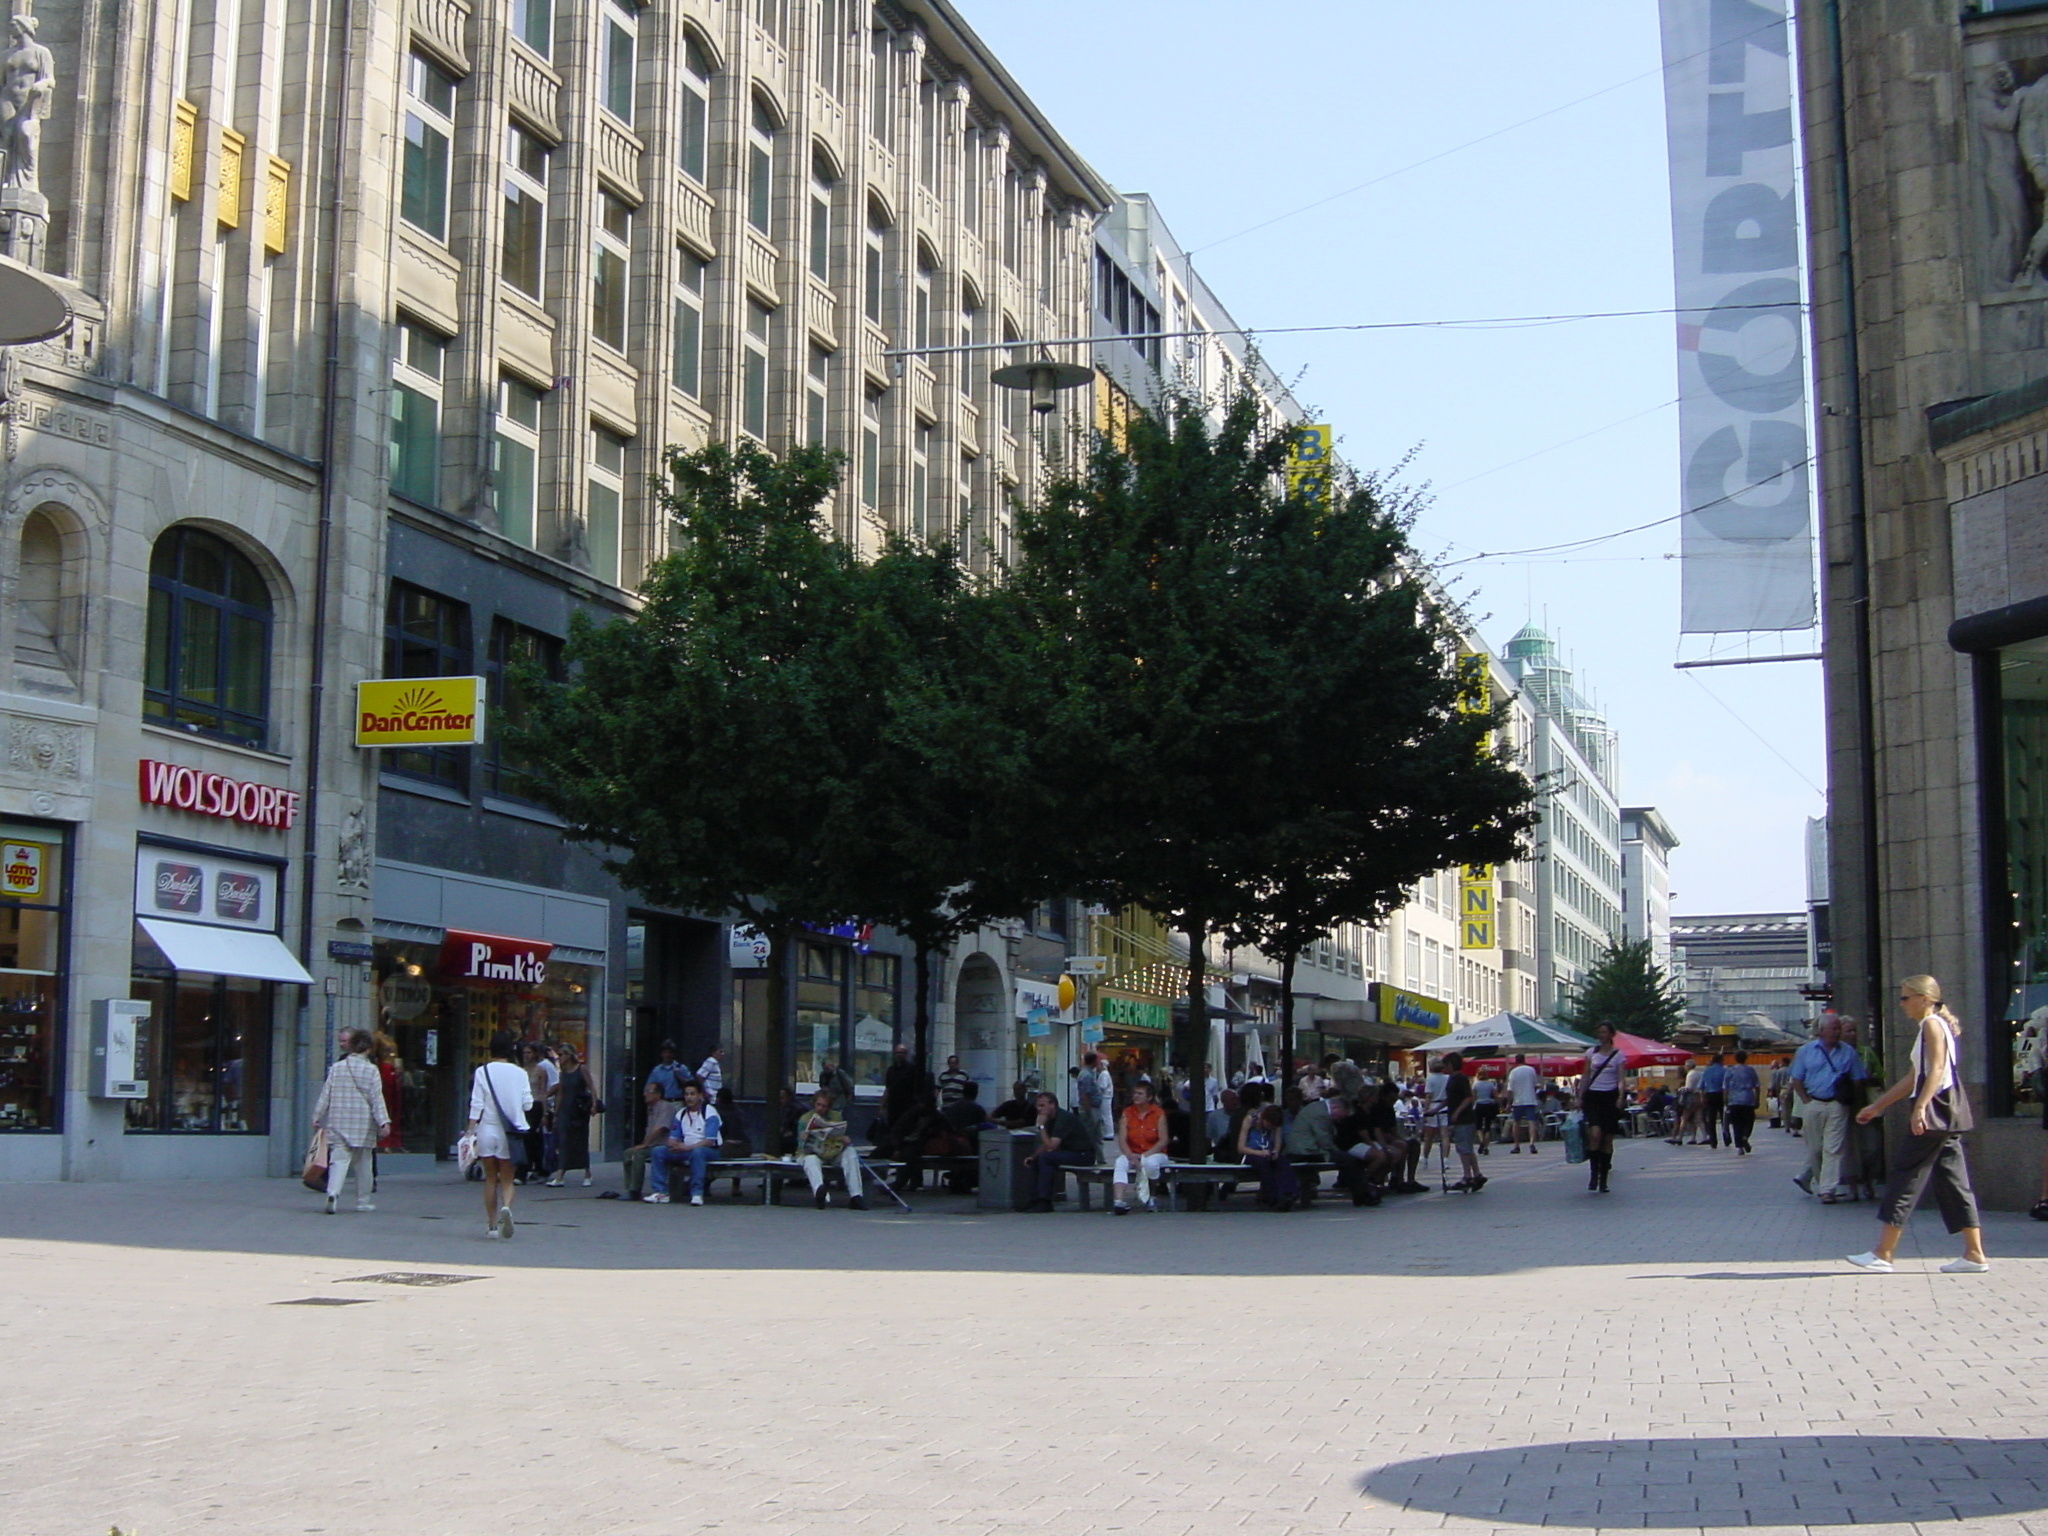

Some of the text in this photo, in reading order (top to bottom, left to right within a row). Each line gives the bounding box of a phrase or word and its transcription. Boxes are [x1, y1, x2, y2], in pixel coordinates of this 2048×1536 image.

[361, 711, 475, 733] DanCenter
[149, 761, 300, 828] WOLSDORFF
[5, 864, 37, 876] LOTTO
[7, 874, 35, 887] TOTO
[464, 942, 546, 984] Pimkie
